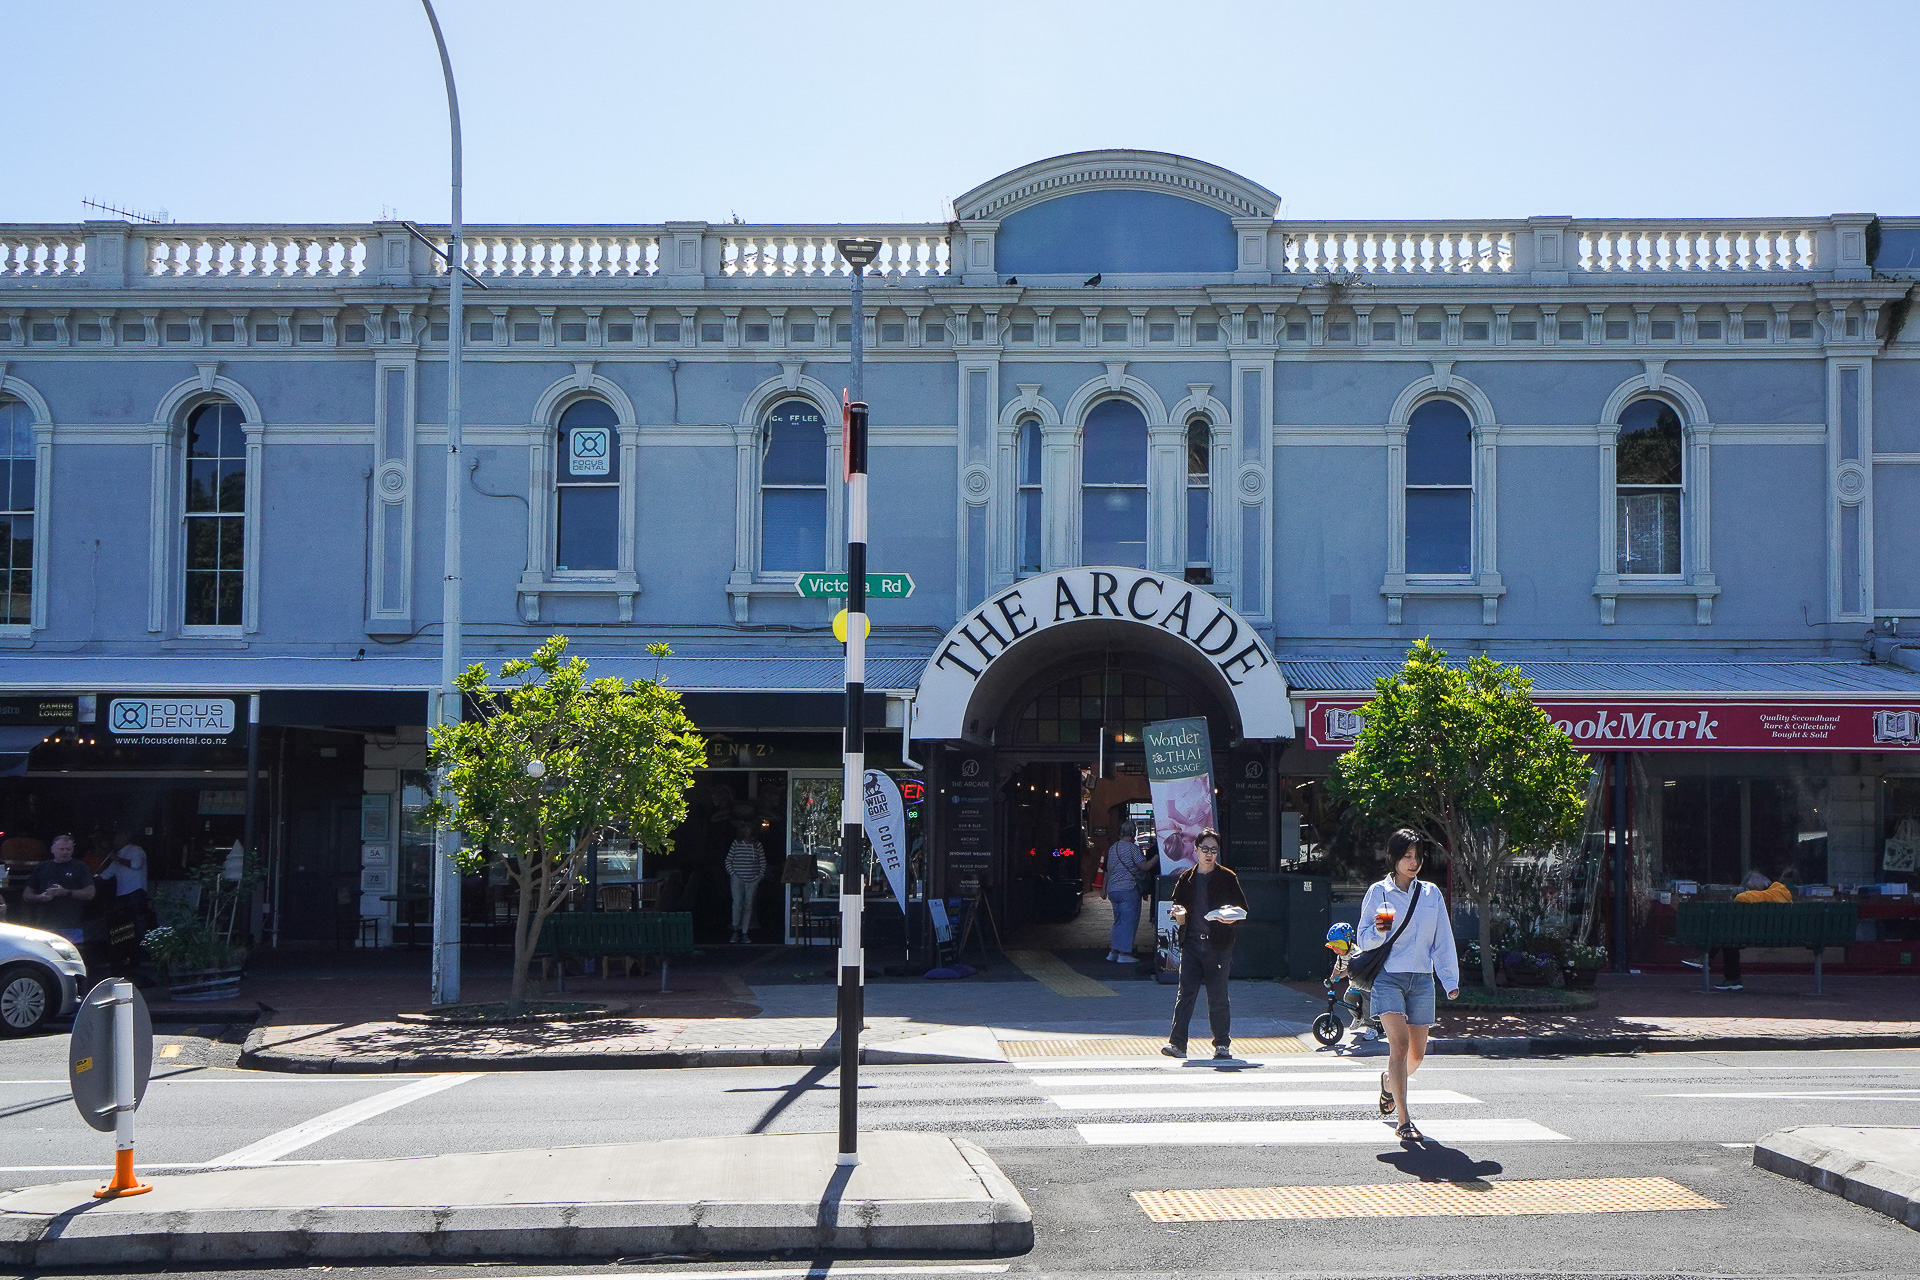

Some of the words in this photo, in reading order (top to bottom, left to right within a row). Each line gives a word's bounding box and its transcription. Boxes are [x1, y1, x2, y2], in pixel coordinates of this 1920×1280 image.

[809, 578, 870, 593] Victoa
[881, 578, 902, 593] Rd
[935, 589, 1038, 682] THE
[1053, 571, 1270, 686] ARCADE
[39, 702, 73, 710] GAMING
[151, 704, 223, 716] FOCUS
[150, 717, 230, 728] DENTAL
[1759, 714, 1790, 722] Quality
[1790, 714, 1841, 722] Secondhand
[1546, 710, 1719, 740] ookMark
[1763, 722, 1783, 730] Rare
[115, 735, 227, 745] www.focusdental.co.nz
[1148, 727, 1200, 748] Wonder
[1771, 731, 1801, 739] Bought
[1809, 731, 1828, 739] Sold
[1165, 748, 1202, 763] THAI
[1155, 762, 1201, 775] MASSAGE
[865, 794, 887, 806] WILD
[868, 802, 889, 815] GOAT
[878, 825, 901, 870] COFFEE
